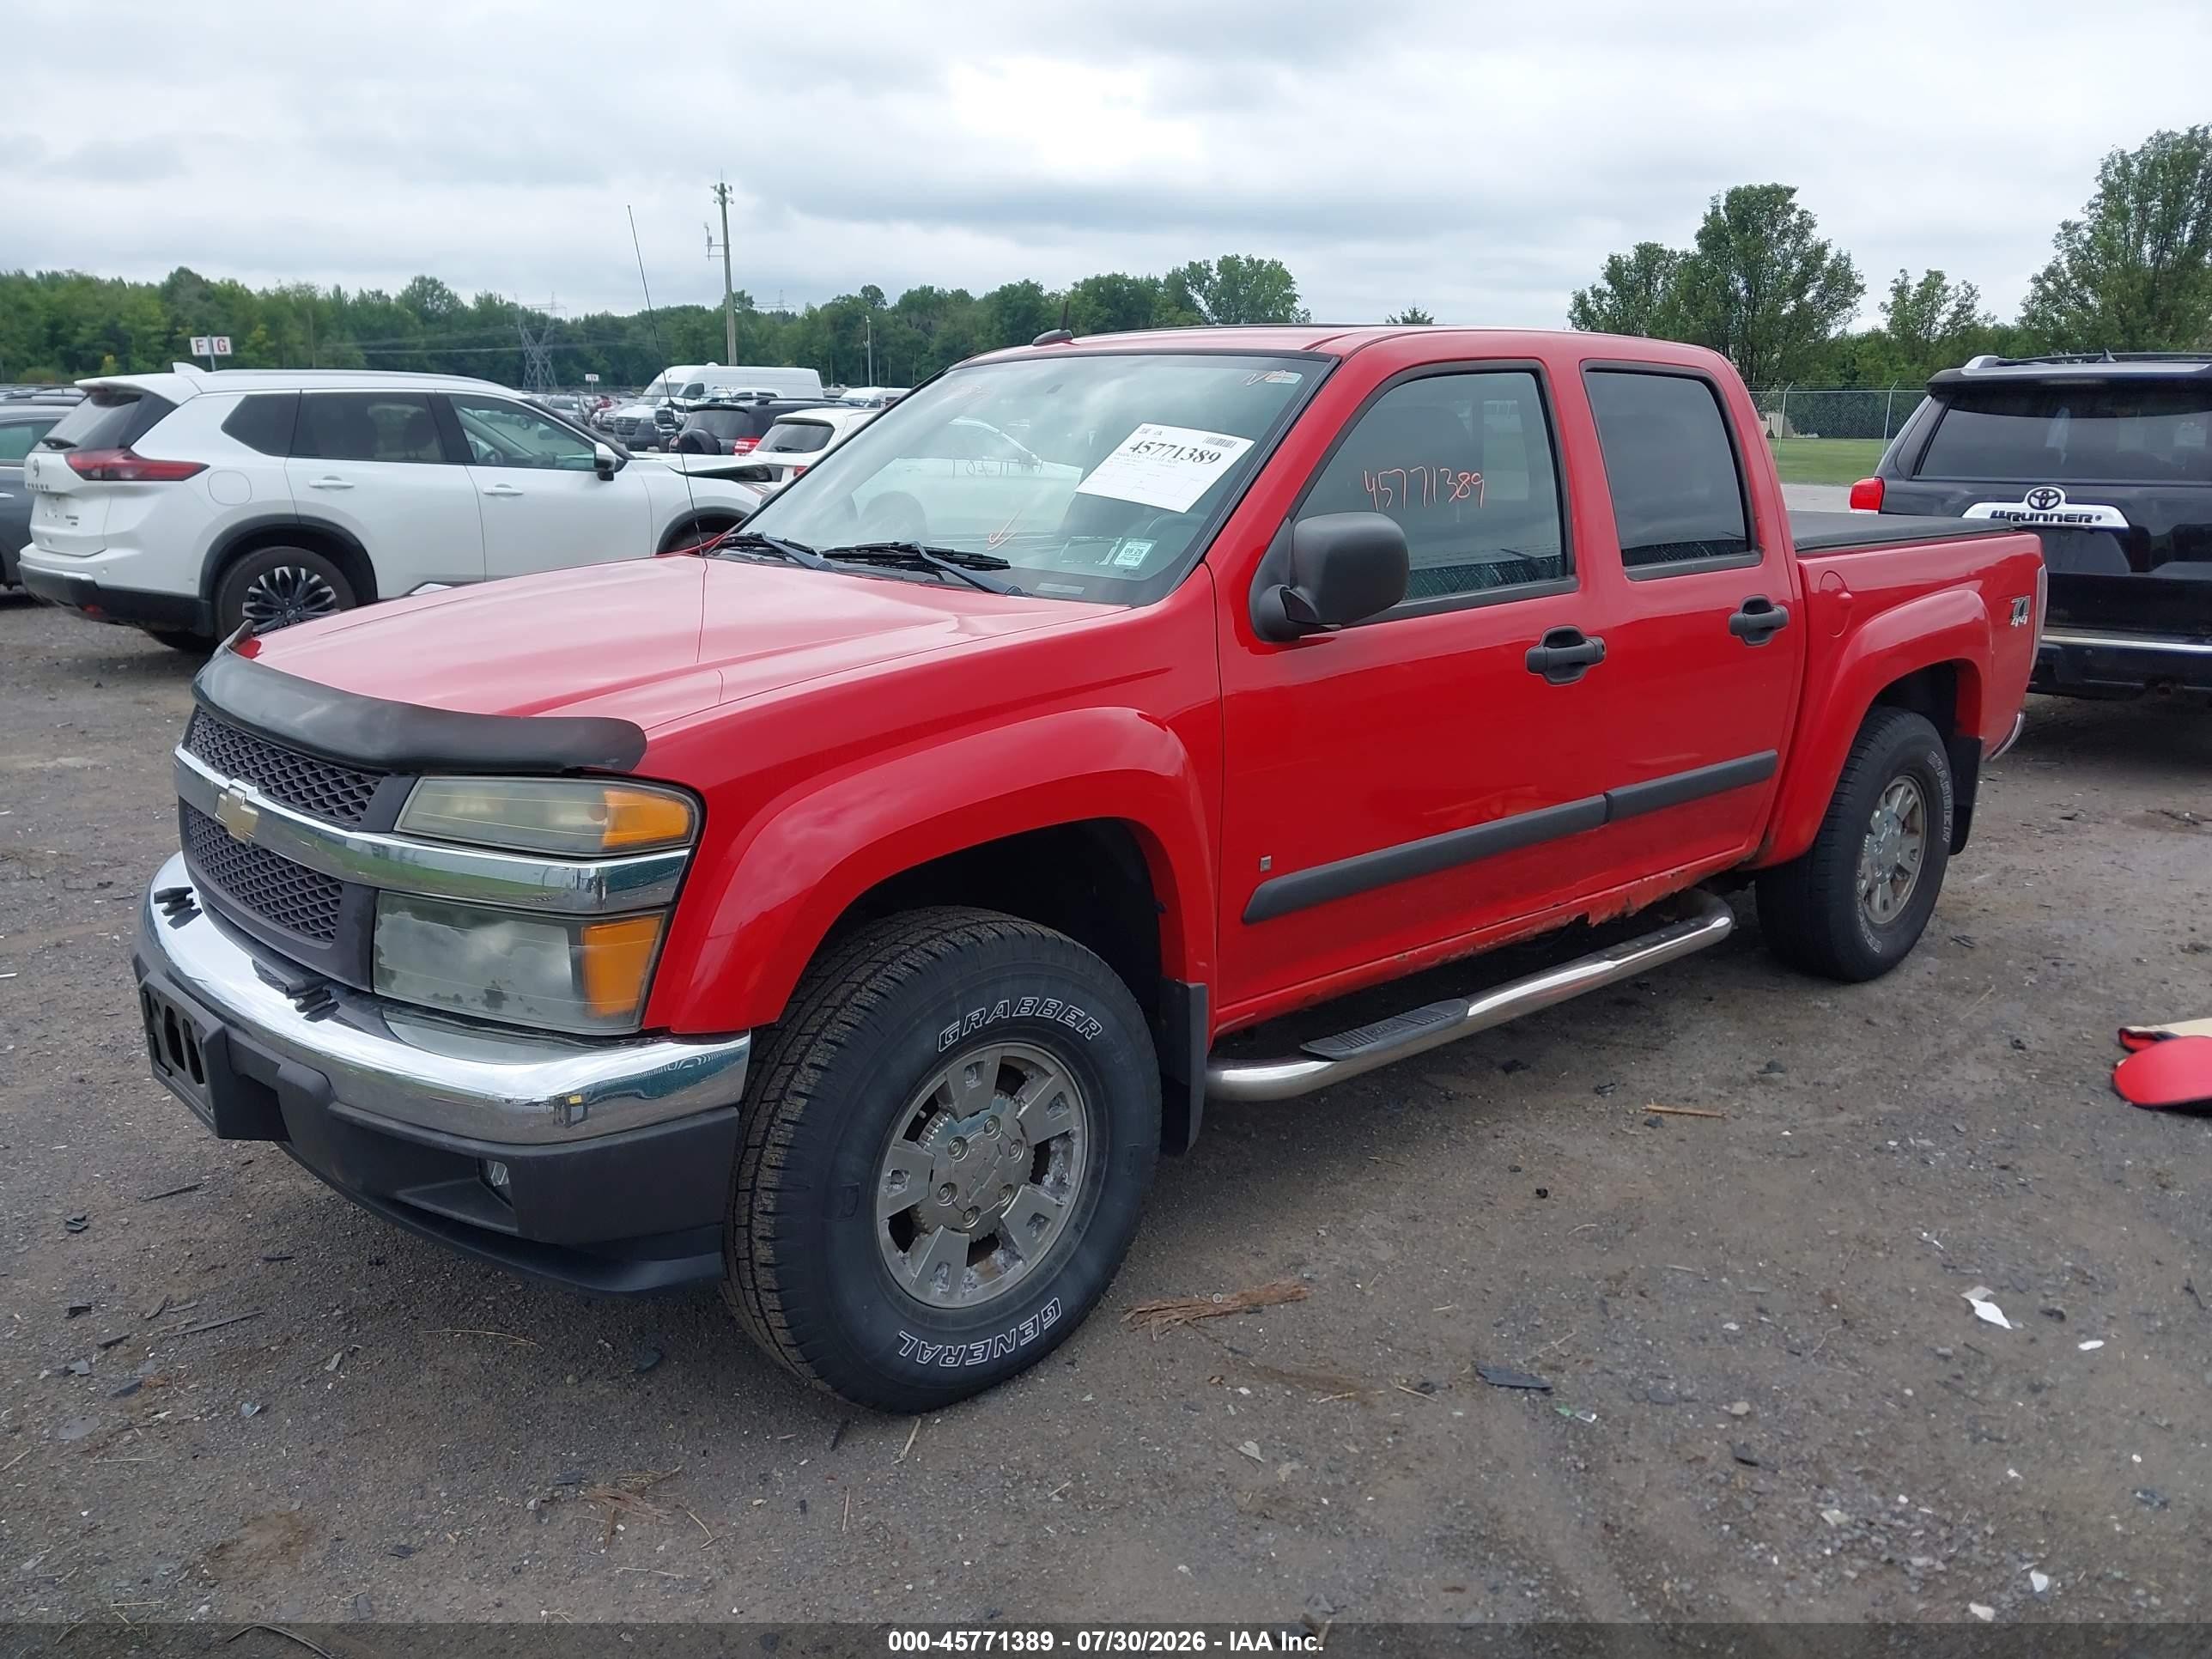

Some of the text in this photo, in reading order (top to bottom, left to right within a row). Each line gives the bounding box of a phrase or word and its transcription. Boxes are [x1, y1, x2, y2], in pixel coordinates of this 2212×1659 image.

[196, 338, 228, 353] F G
[1128, 441, 1222, 465] 45771389
[1364, 466, 1485, 513] 45771389
[1990, 510, 2094, 523] 4RUNNER
[938, 997, 1103, 1052] GRABBER
[898, 1297, 1062, 1367] GENERAL
